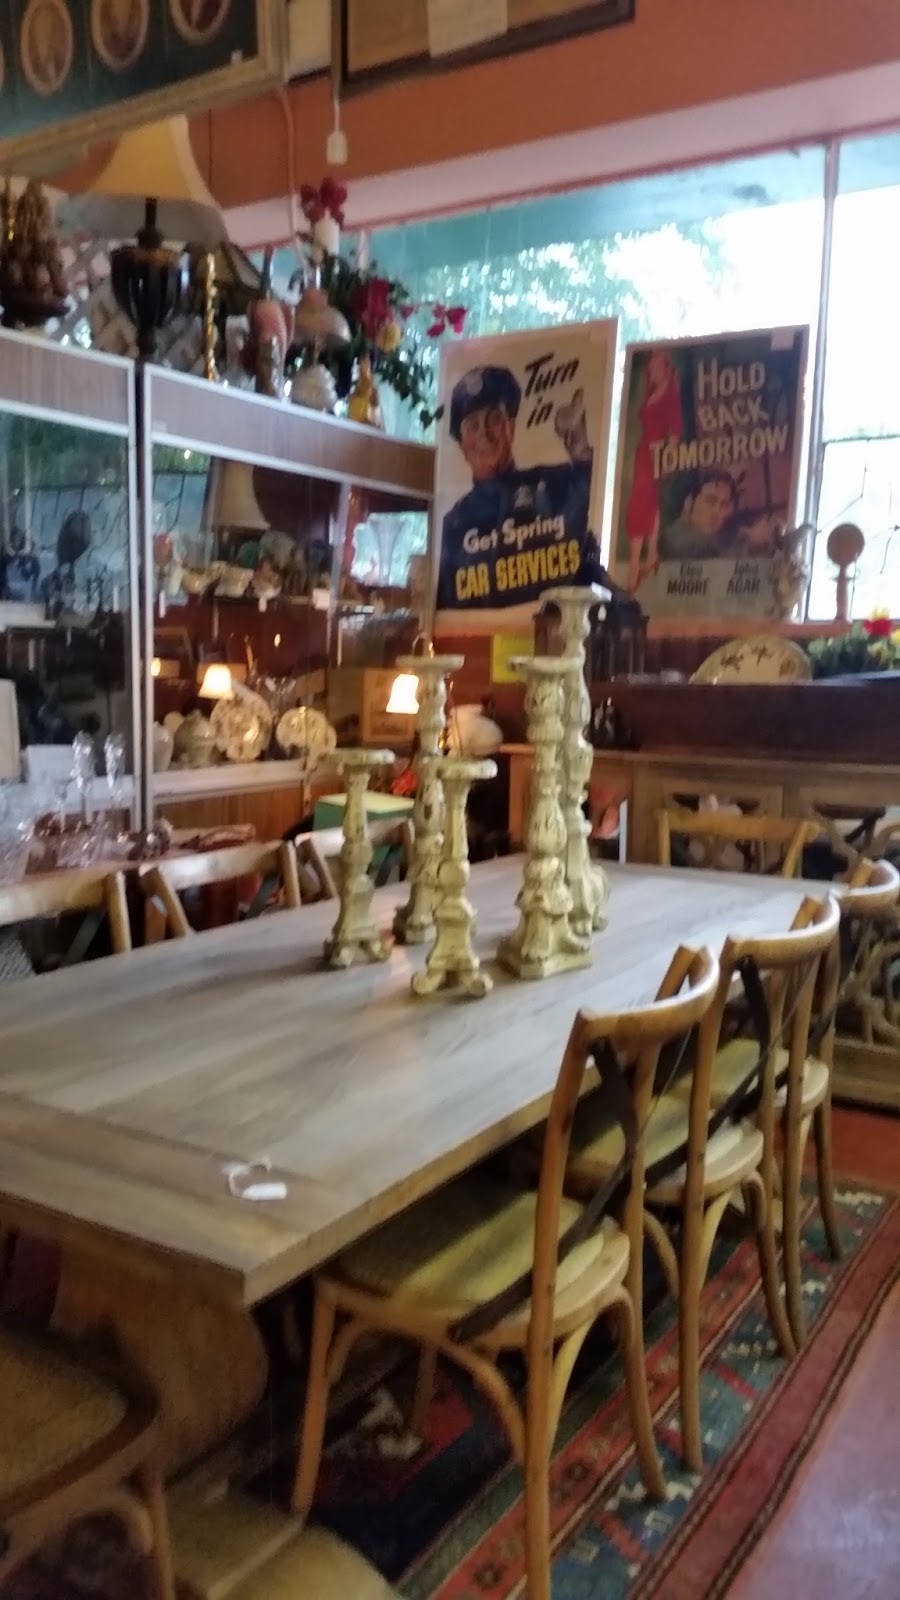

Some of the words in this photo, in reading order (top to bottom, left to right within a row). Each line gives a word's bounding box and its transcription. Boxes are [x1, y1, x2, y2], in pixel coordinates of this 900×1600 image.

[524, 353, 580, 399] Turn
[697, 356, 766, 400] HOLD
[526, 400, 553, 430] in
[698, 395, 768, 432] BACK
[649, 425, 789, 479] TOMORROW
[463, 526, 498, 554] Get
[502, 513, 565, 550] Spring
[455, 562, 490, 601] CAR
[495, 538, 581, 592] SERVICES
